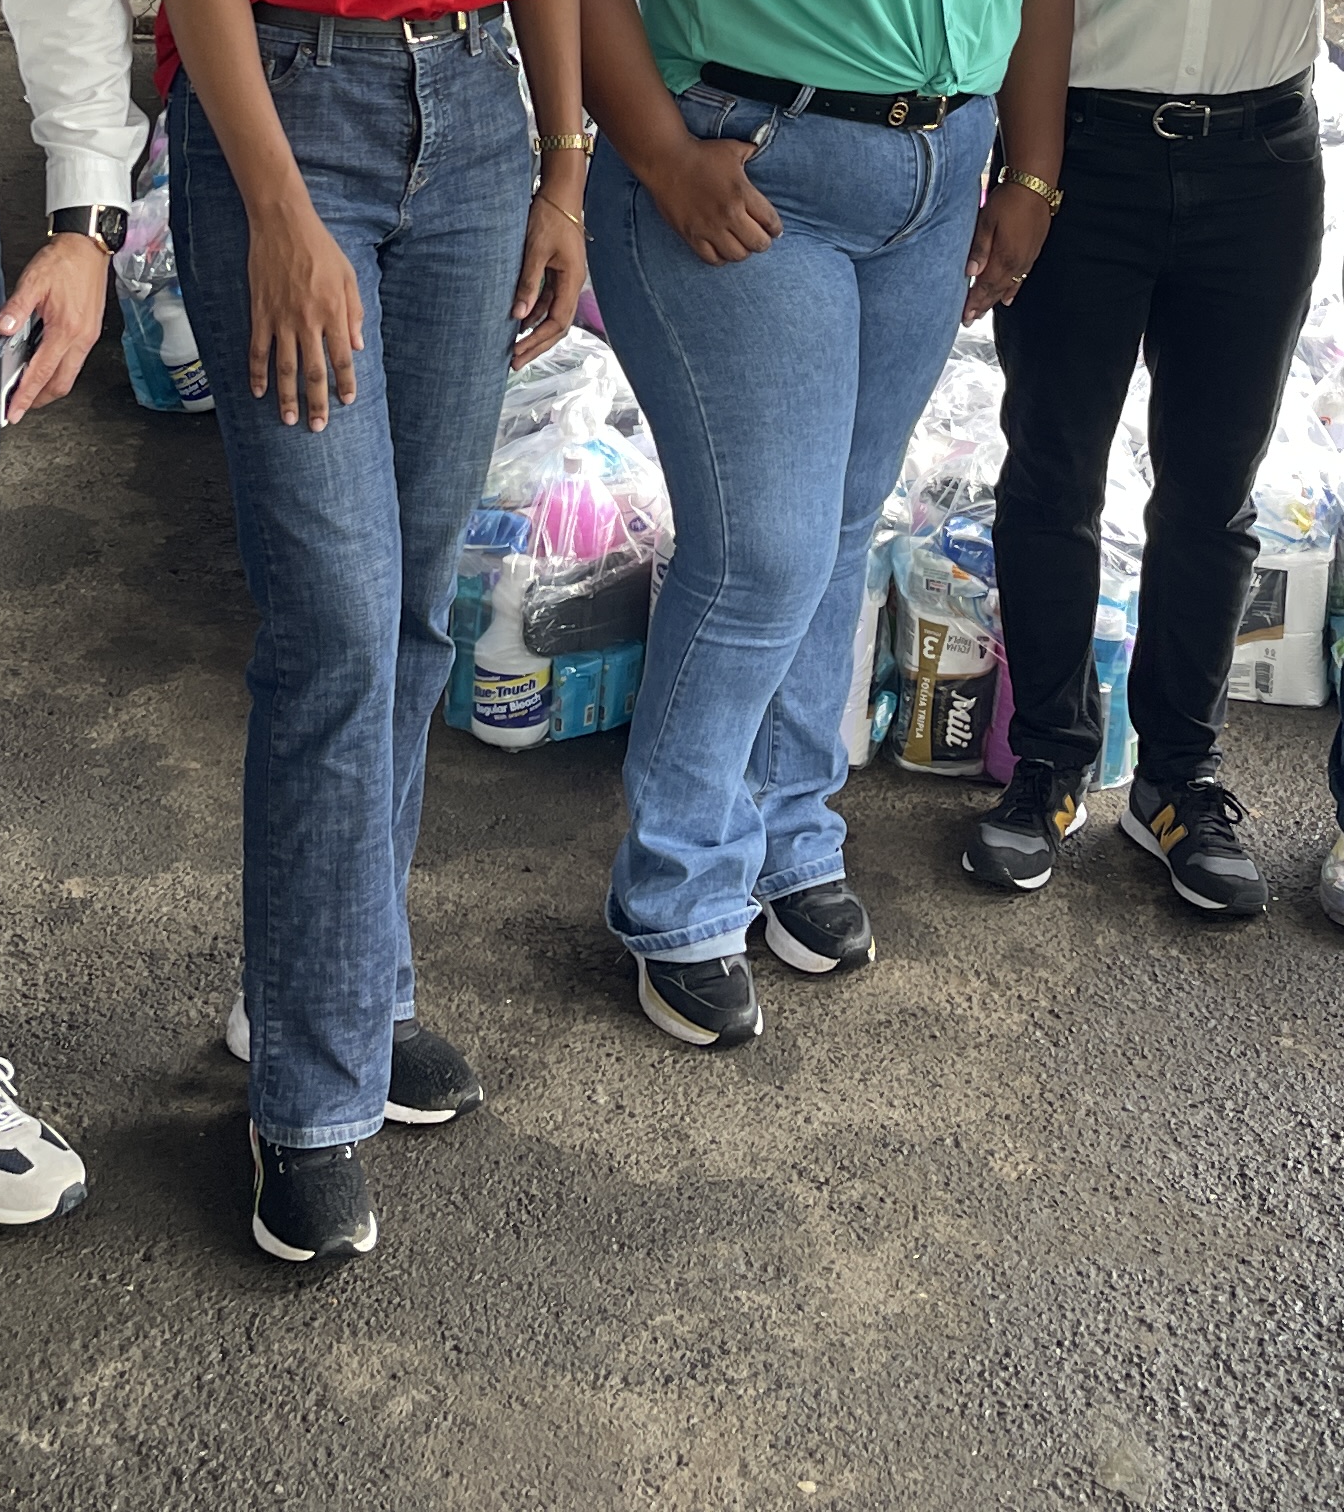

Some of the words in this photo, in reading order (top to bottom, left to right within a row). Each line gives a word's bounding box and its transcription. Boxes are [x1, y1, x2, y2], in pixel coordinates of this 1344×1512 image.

[922, 635, 940, 660] 3
[509, 692, 542, 712] Bleach
[917, 676, 931, 703] FOLHA
[915, 703, 926, 739] TRIPLA
[945, 689, 978, 749] Mili
